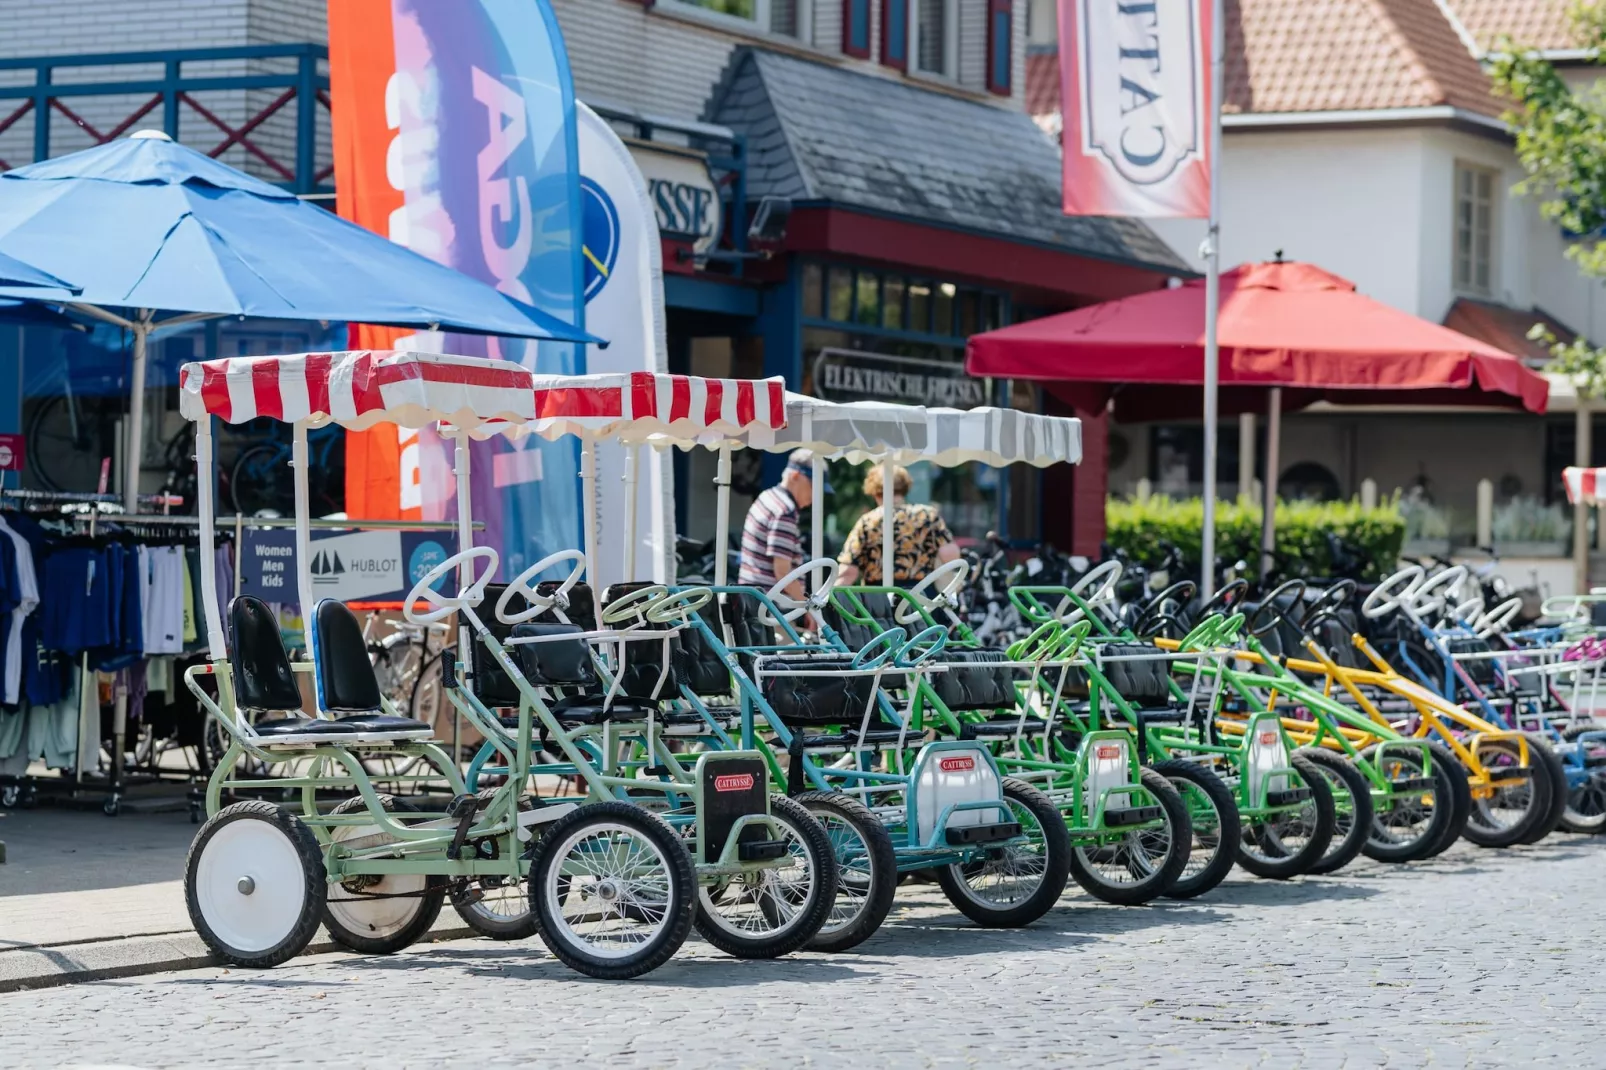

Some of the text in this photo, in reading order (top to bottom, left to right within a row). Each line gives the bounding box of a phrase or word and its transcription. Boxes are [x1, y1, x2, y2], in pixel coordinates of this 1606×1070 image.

[255, 544, 292, 556] Women
[262, 560, 284, 571] Men
[351, 559, 396, 572] HUBLOT
[262, 574, 284, 587] Kids
[717, 777, 751, 788] CATTRYSSE
